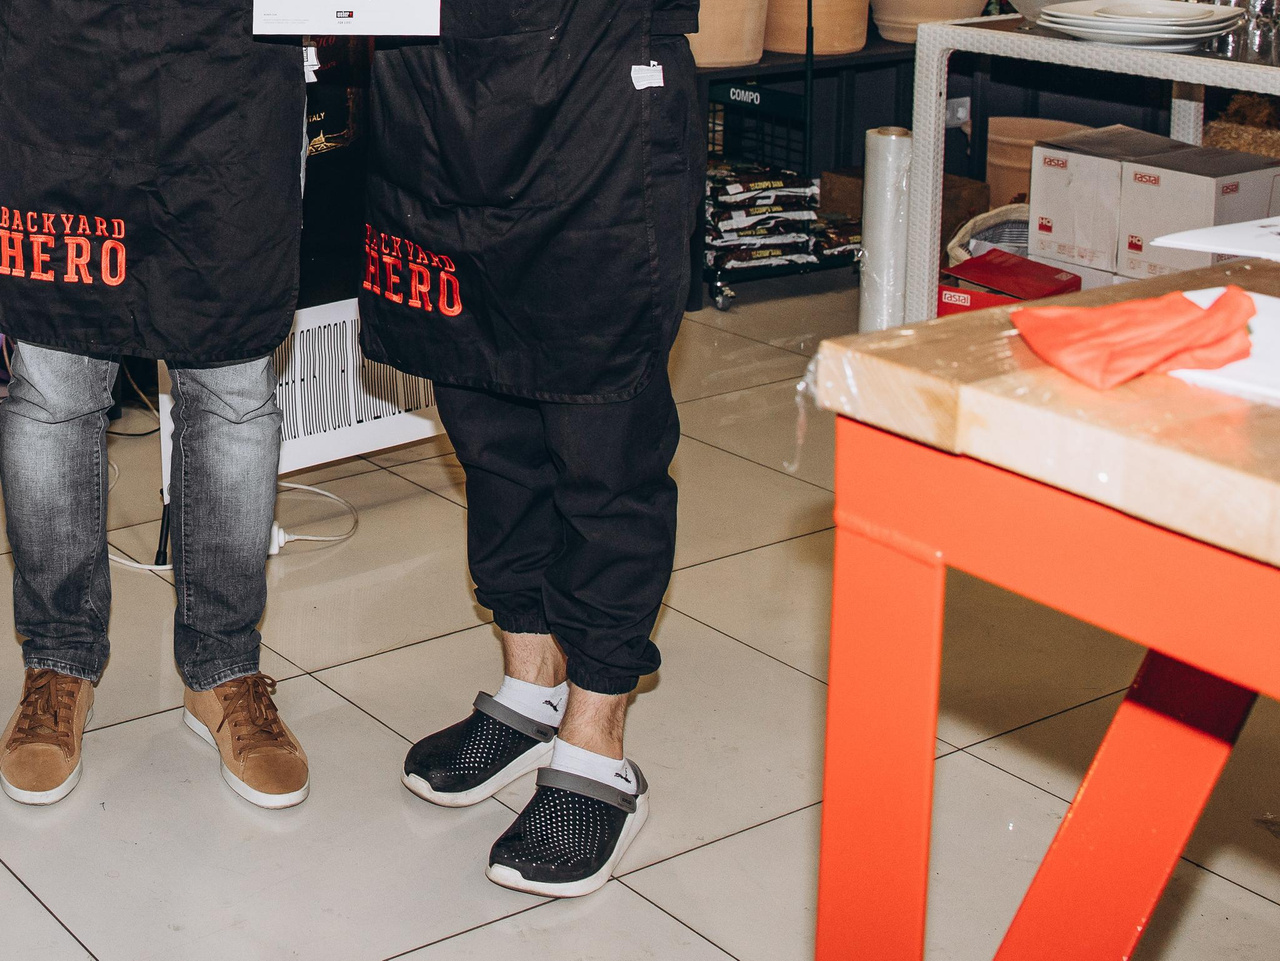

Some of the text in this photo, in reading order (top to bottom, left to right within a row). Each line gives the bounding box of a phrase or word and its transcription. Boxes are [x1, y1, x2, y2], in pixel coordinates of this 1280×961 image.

[729, 87, 761, 105] COMPO
[308, 111, 326, 123] TALY
[0, 206, 125, 239] BACKYARD
[363, 244, 463, 317] HERO
[942, 291, 970, 306] rastal
